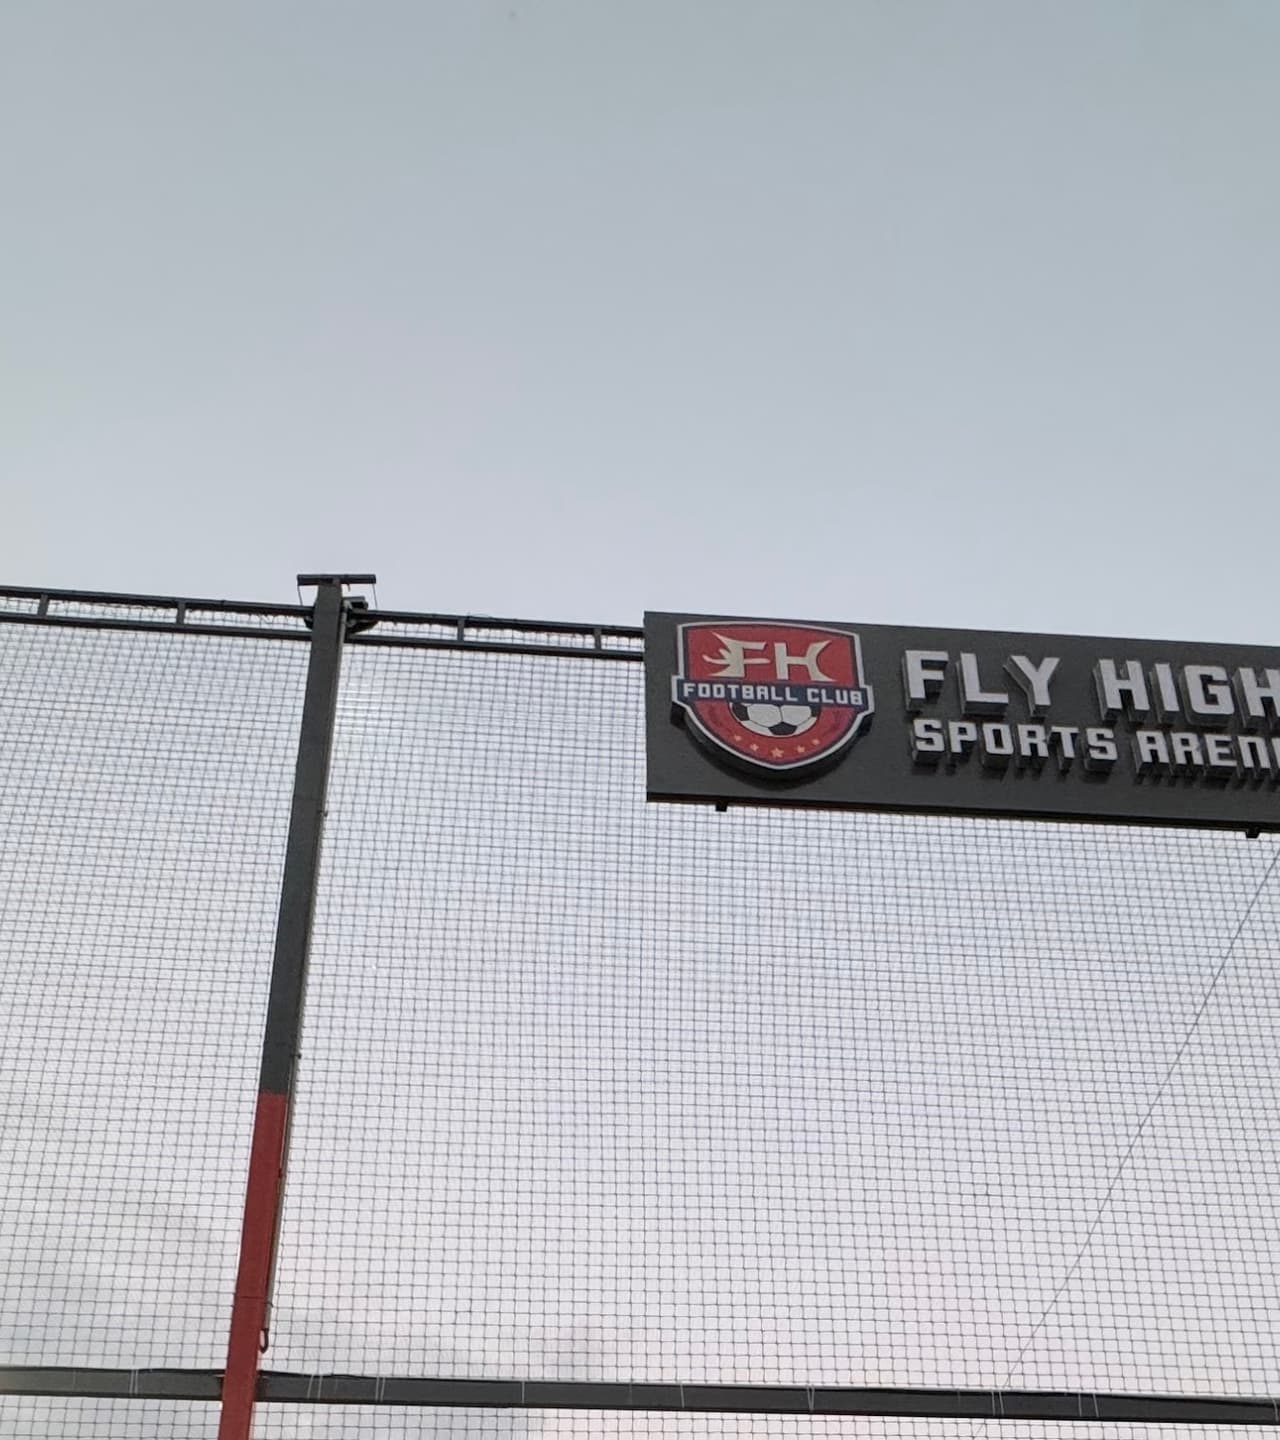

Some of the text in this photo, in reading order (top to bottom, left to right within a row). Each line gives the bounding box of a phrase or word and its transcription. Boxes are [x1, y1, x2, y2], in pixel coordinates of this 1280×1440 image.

[683, 682, 863, 706] FOOTBALL CLUB
[904, 650, 1061, 706] FLY
[913, 718, 1119, 761] SPORTS
